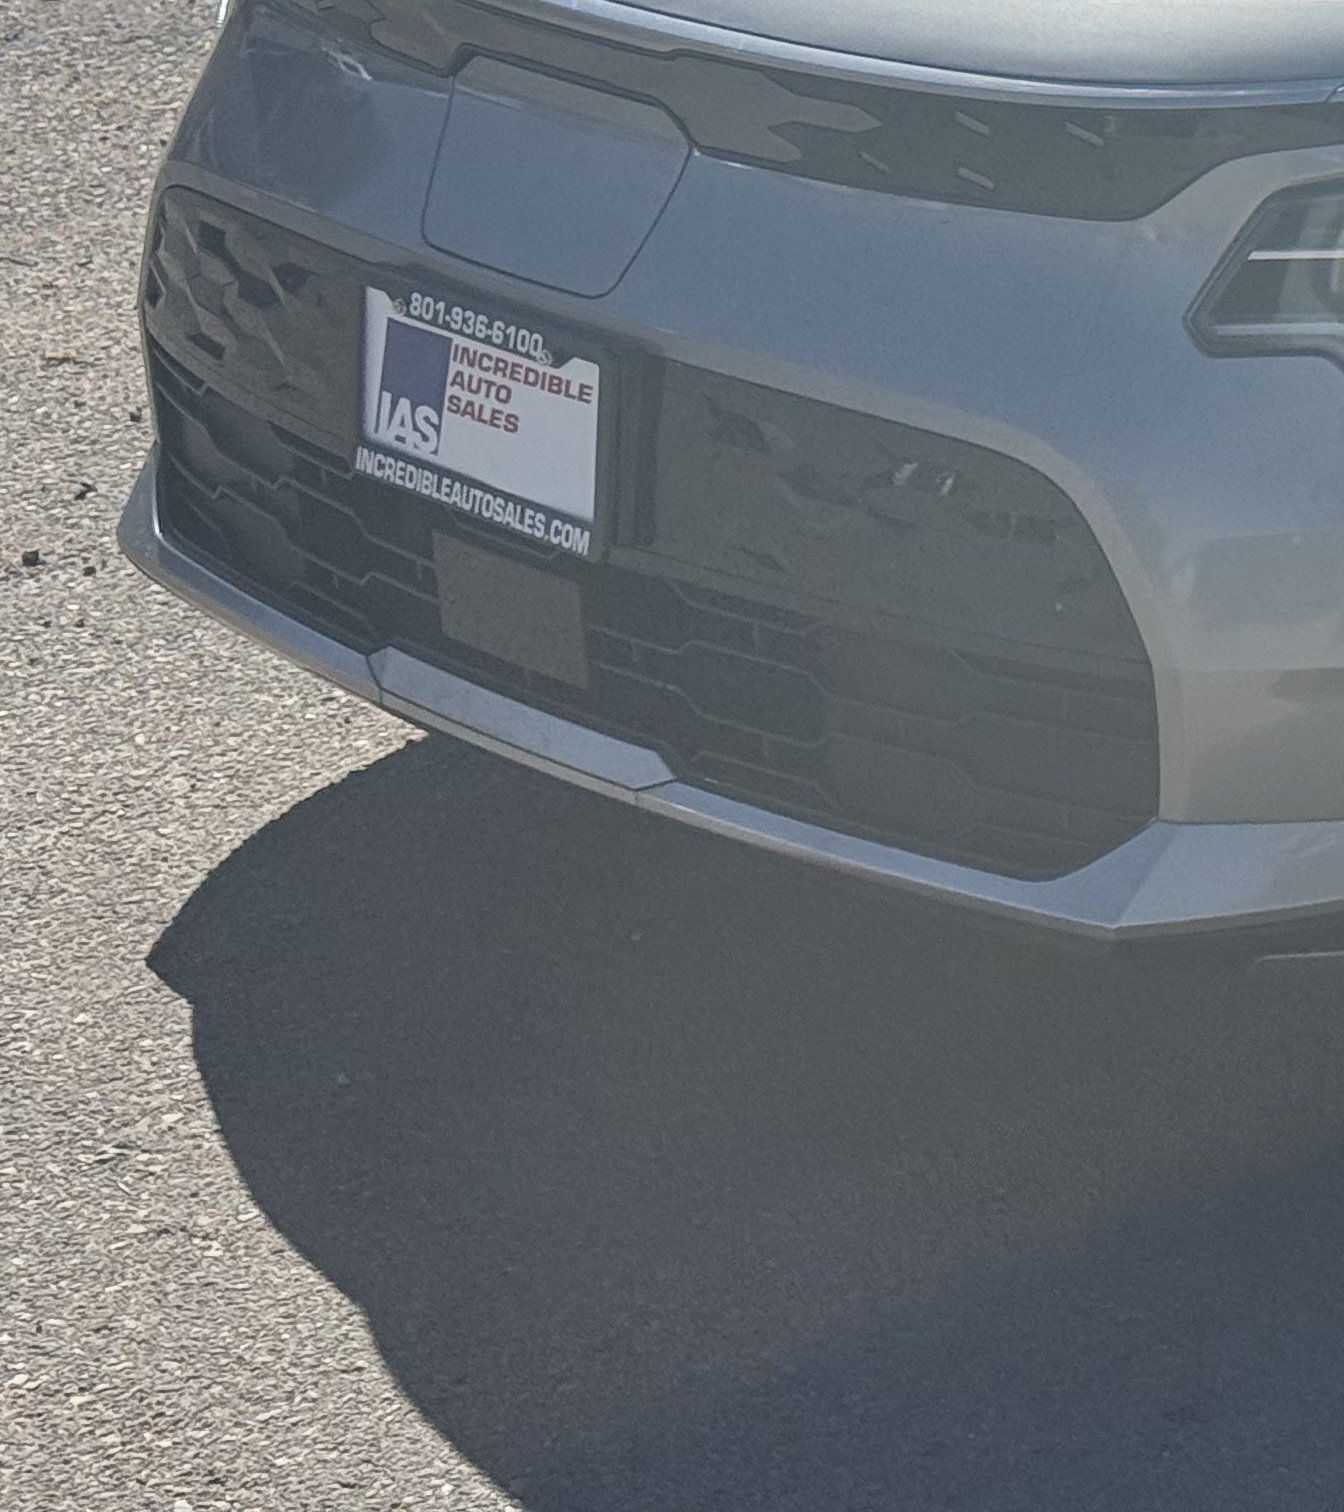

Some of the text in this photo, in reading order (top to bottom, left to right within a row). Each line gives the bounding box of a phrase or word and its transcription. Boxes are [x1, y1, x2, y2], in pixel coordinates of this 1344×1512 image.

[409, 292, 544, 357] 801-936-6100
[449, 370, 513, 405] AUTO
[452, 343, 594, 404] INCREDIBLE
[376, 390, 440, 456] IAS
[446, 394, 520, 434] SALES
[355, 445, 592, 557] INCREDIBLEAUTOSALES.COM
